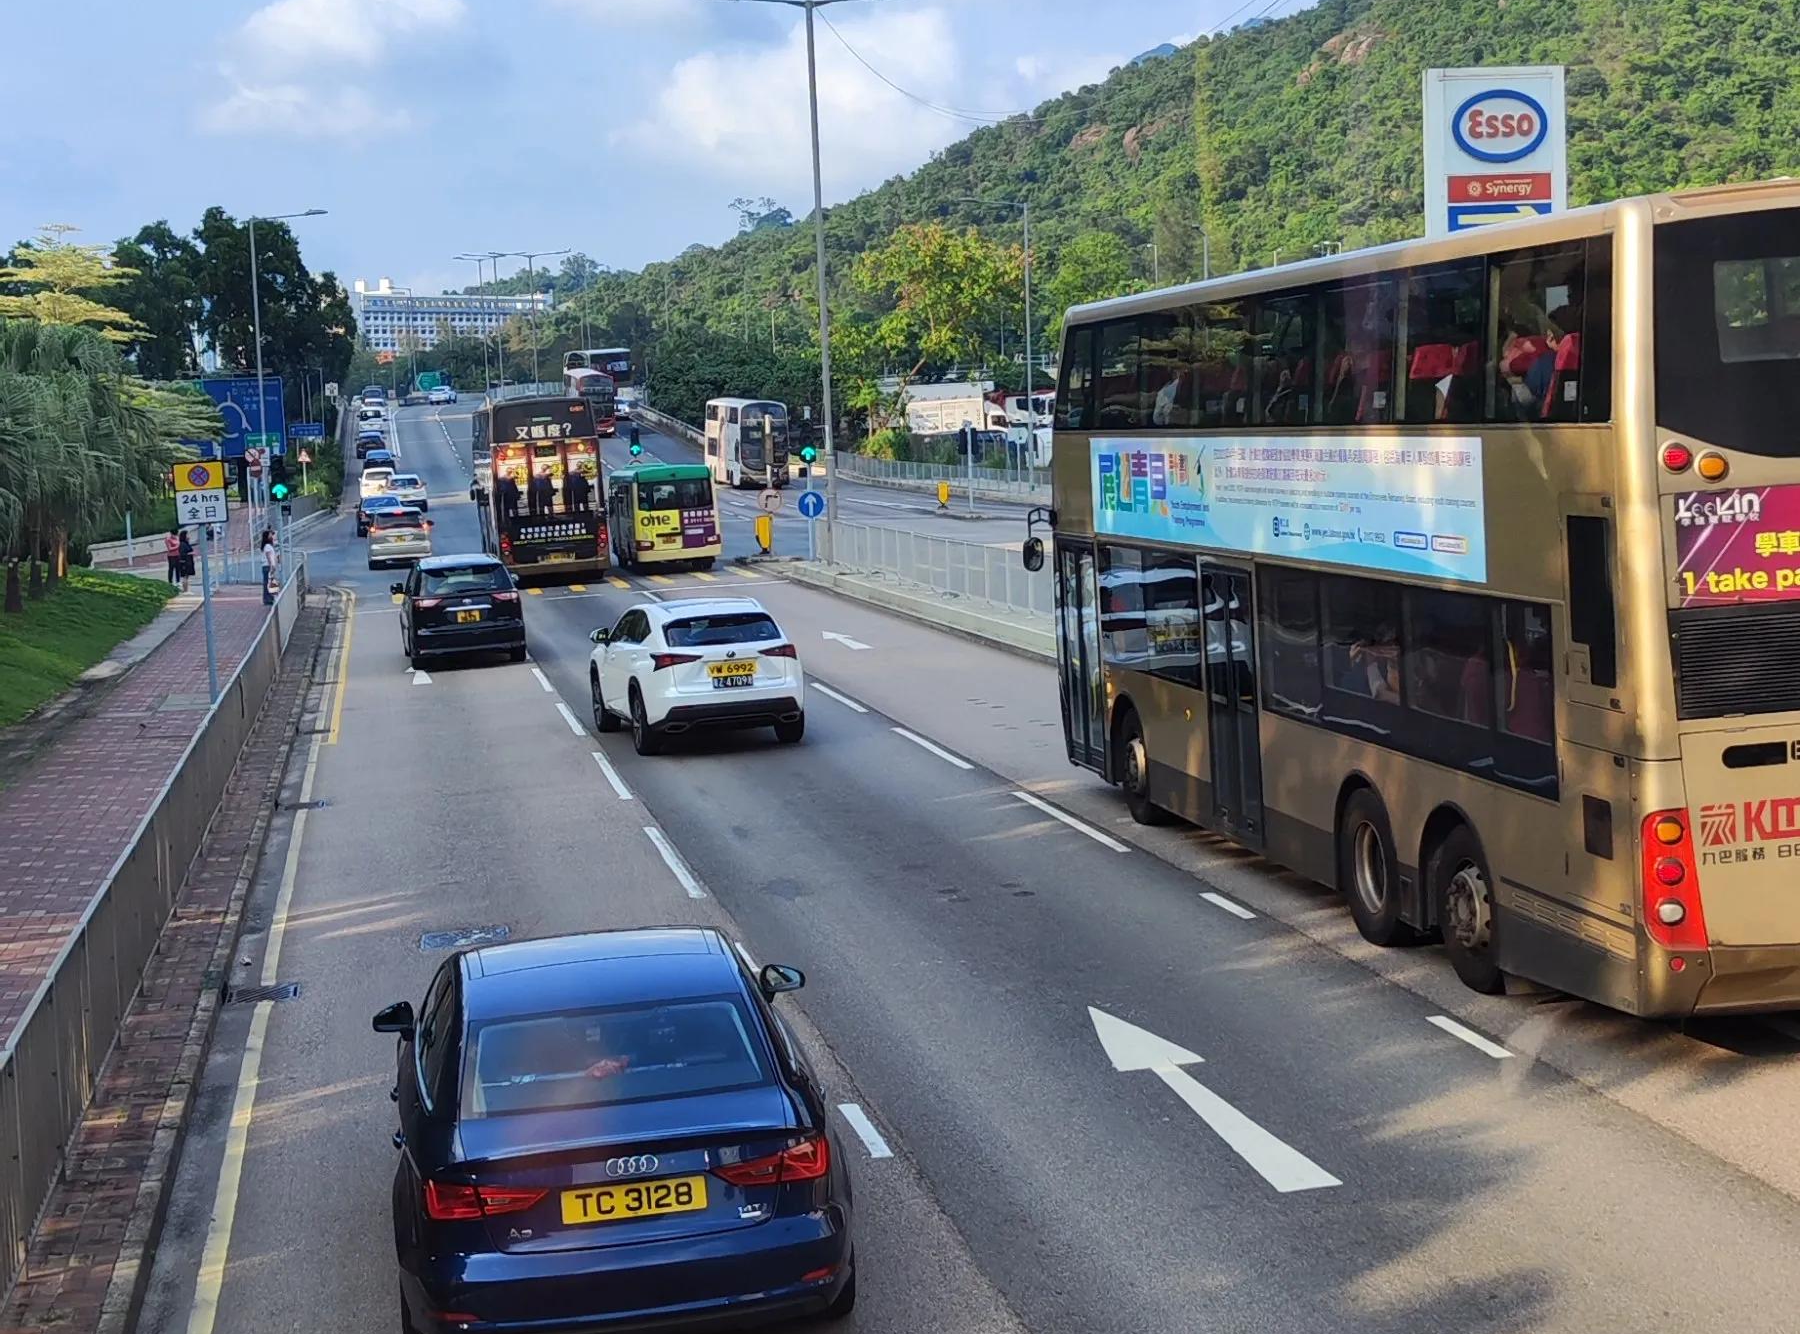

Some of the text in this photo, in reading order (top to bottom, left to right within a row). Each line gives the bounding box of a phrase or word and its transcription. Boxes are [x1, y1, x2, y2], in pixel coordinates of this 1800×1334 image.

[1468, 109, 1534, 139] Esso
[1486, 181, 1532, 196] Synergy
[182, 494, 219, 504] 24 hrs
[641, 515, 671, 527] one
[1683, 571, 1696, 595] 1
[1706, 568, 1769, 593] take
[727, 663, 754, 673] 6992
[575, 1181, 693, 1217] TC 3128
